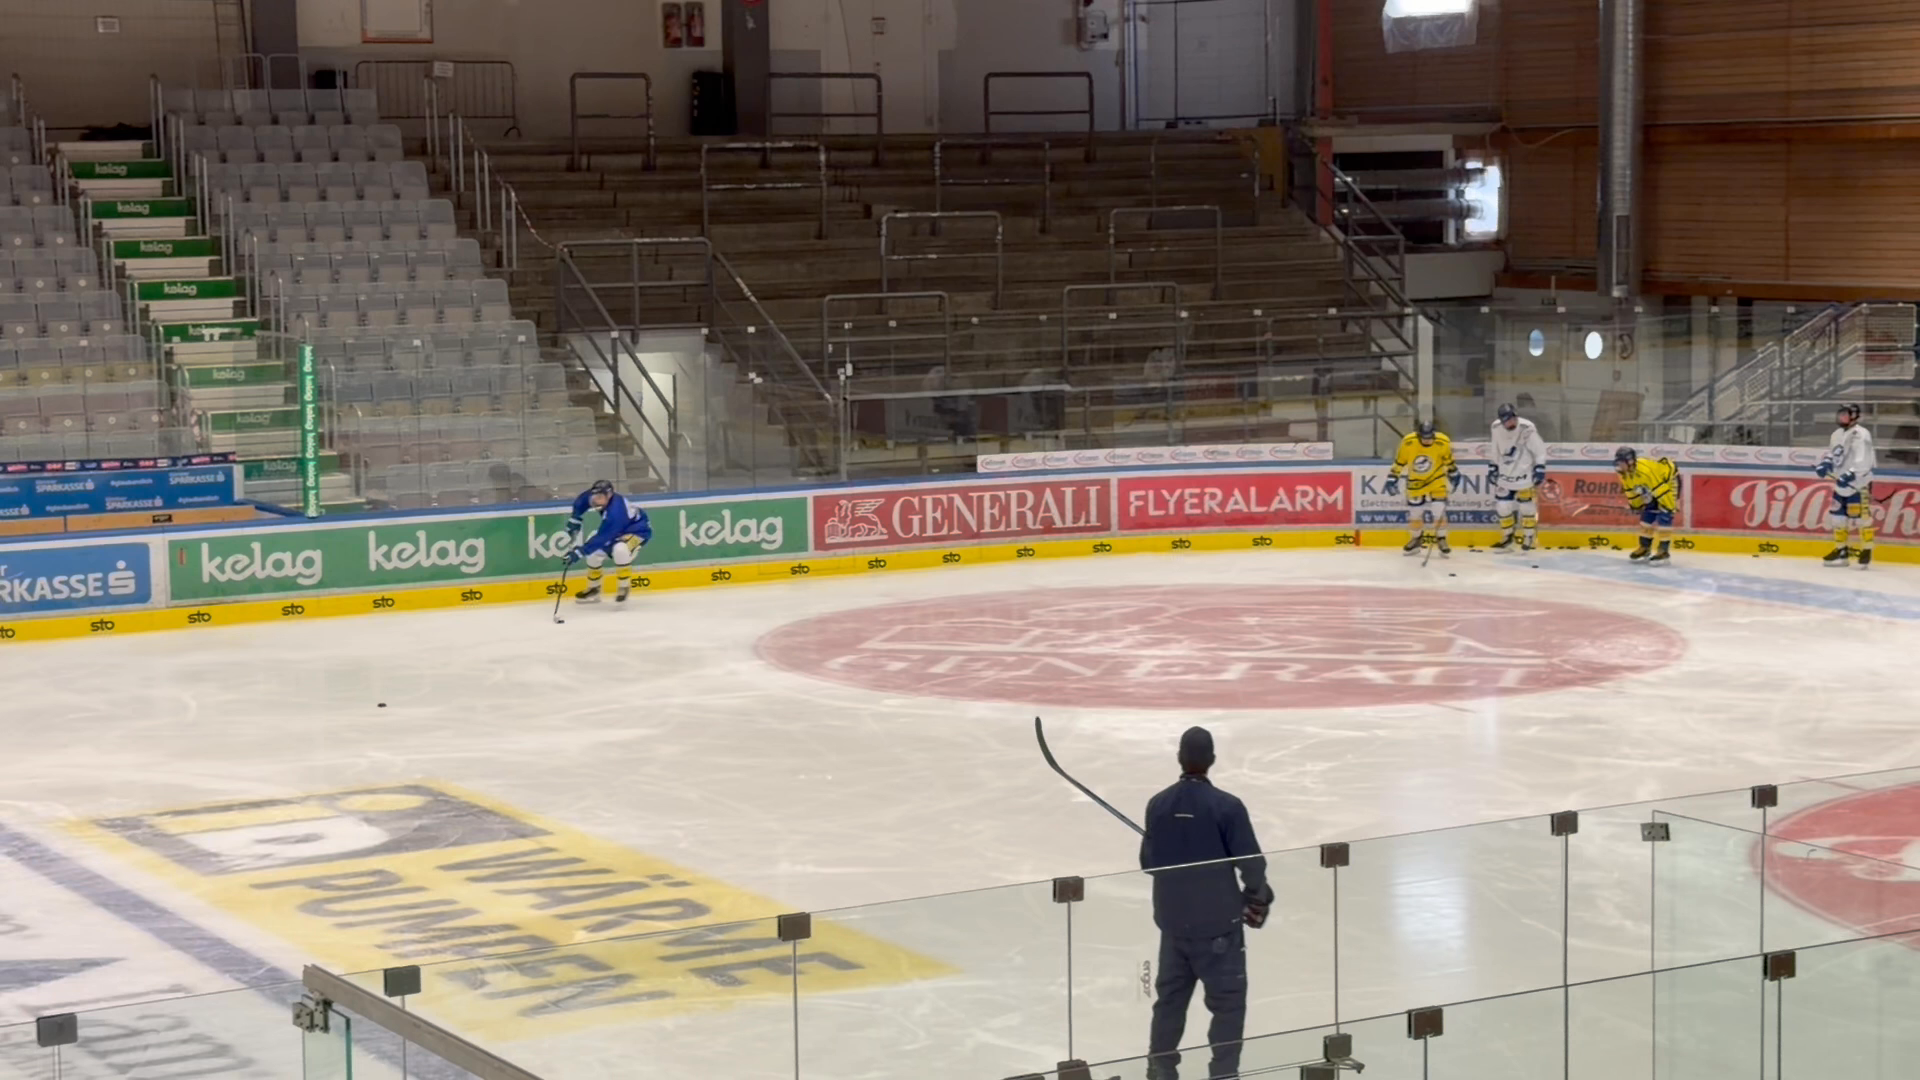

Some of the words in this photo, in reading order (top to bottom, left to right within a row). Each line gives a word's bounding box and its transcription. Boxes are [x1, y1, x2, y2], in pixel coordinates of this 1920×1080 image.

[1128, 484, 1345, 518] FLYERALARM
[891, 485, 1102, 539] GENERALI
[679, 508, 784, 551] kelag
[1171, 537, 1192, 550] sto
[1252, 534, 1273, 548] sto
[1335, 533, 1355, 546] sto
[1588, 535, 1610, 548] sto
[1673, 537, 1695, 550] sto
[368, 529, 486, 575] kelag
[1016, 545, 1036, 558] sto
[1092, 541, 1113, 554] sto
[1758, 541, 1780, 554] sto
[201, 541, 323, 586] kelag
[867, 556, 887, 570] sto
[942, 551, 961, 564] sto
[711, 568, 732, 582] sto
[790, 562, 811, 576] sto
[631, 575, 651, 588] sto
[372, 595, 396, 609] sto
[460, 588, 484, 602] sto
[281, 603, 305, 616] sto
[187, 610, 212, 624] sto
[90, 617, 115, 632] sto
[825, 652, 1538, 690] GENERALI
[435, 845, 866, 987] WÄRME
